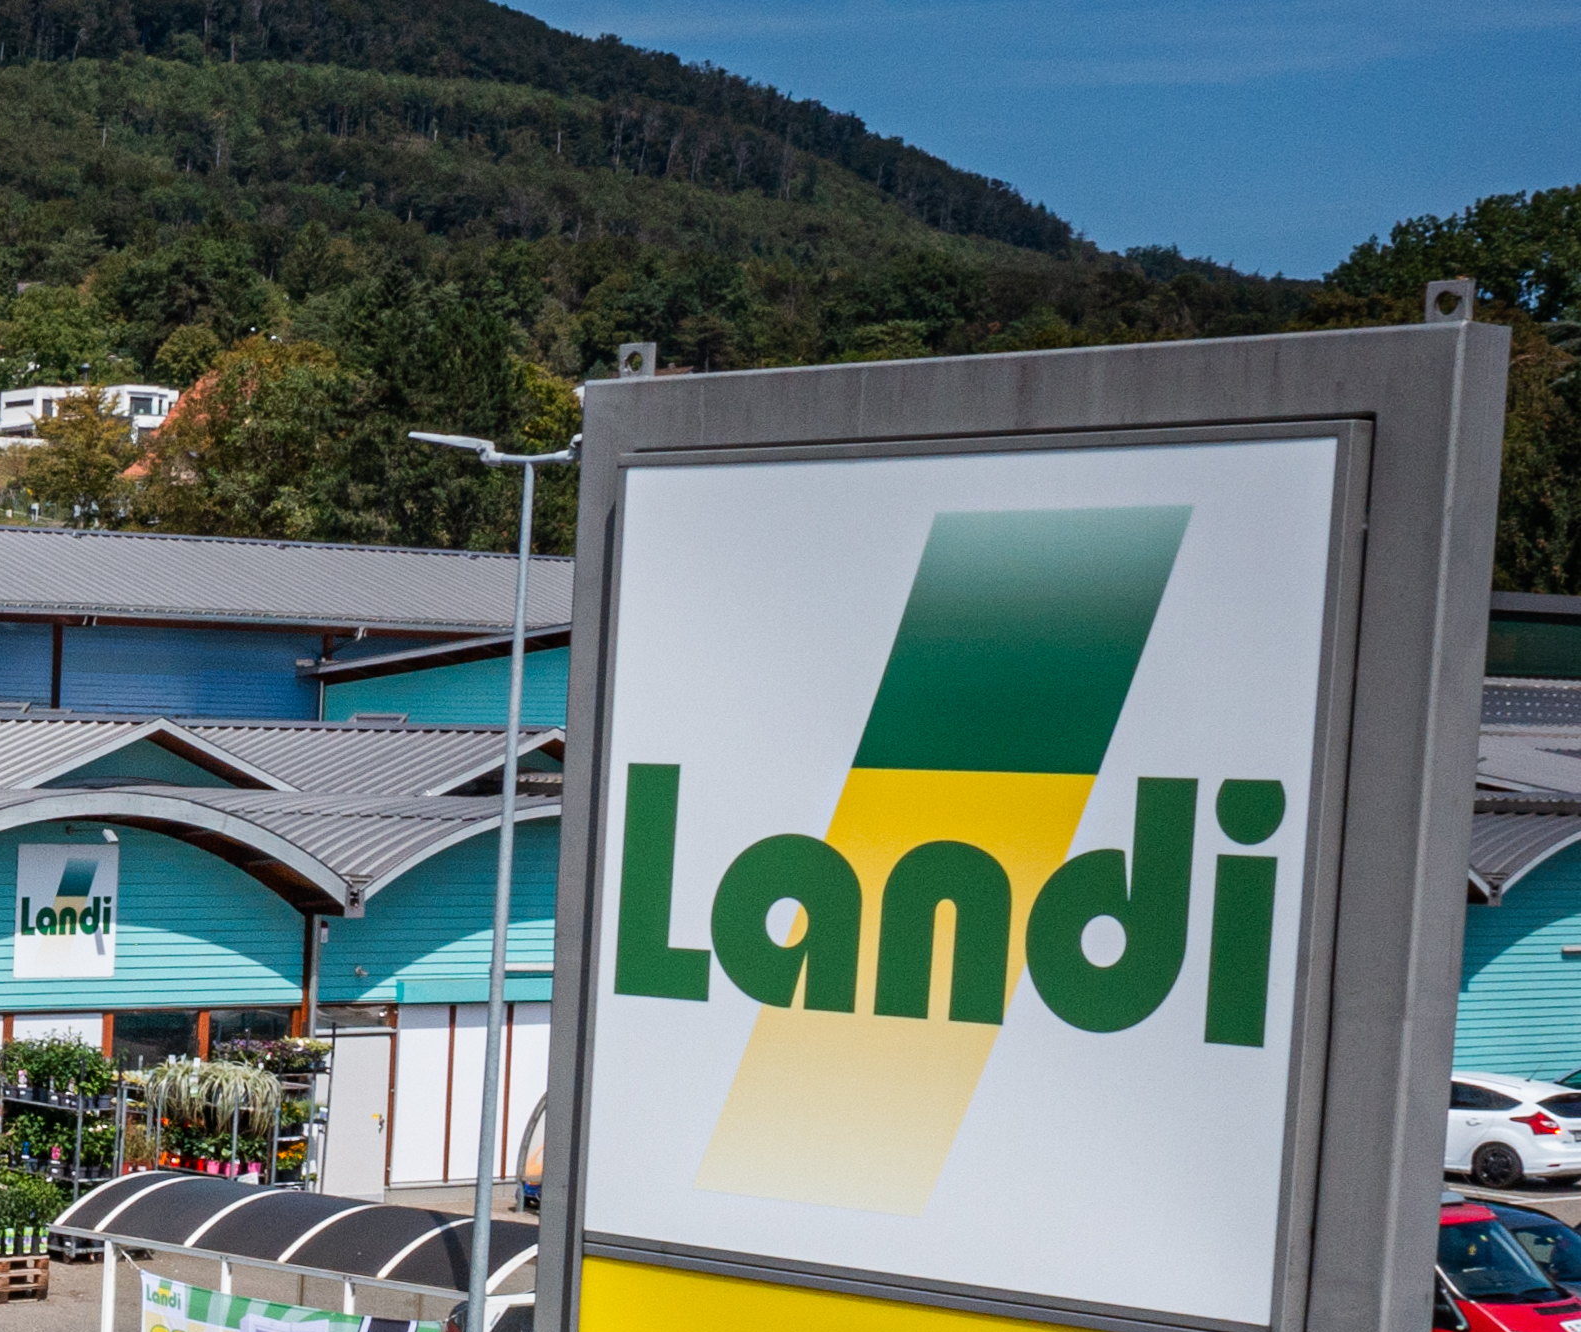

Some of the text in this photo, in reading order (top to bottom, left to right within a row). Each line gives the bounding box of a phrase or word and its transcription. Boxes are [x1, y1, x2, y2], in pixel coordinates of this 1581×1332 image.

[21, 896, 112, 935] Landi
[614, 762, 1286, 1048] Landi
[146, 1284, 182, 1310] Landi
